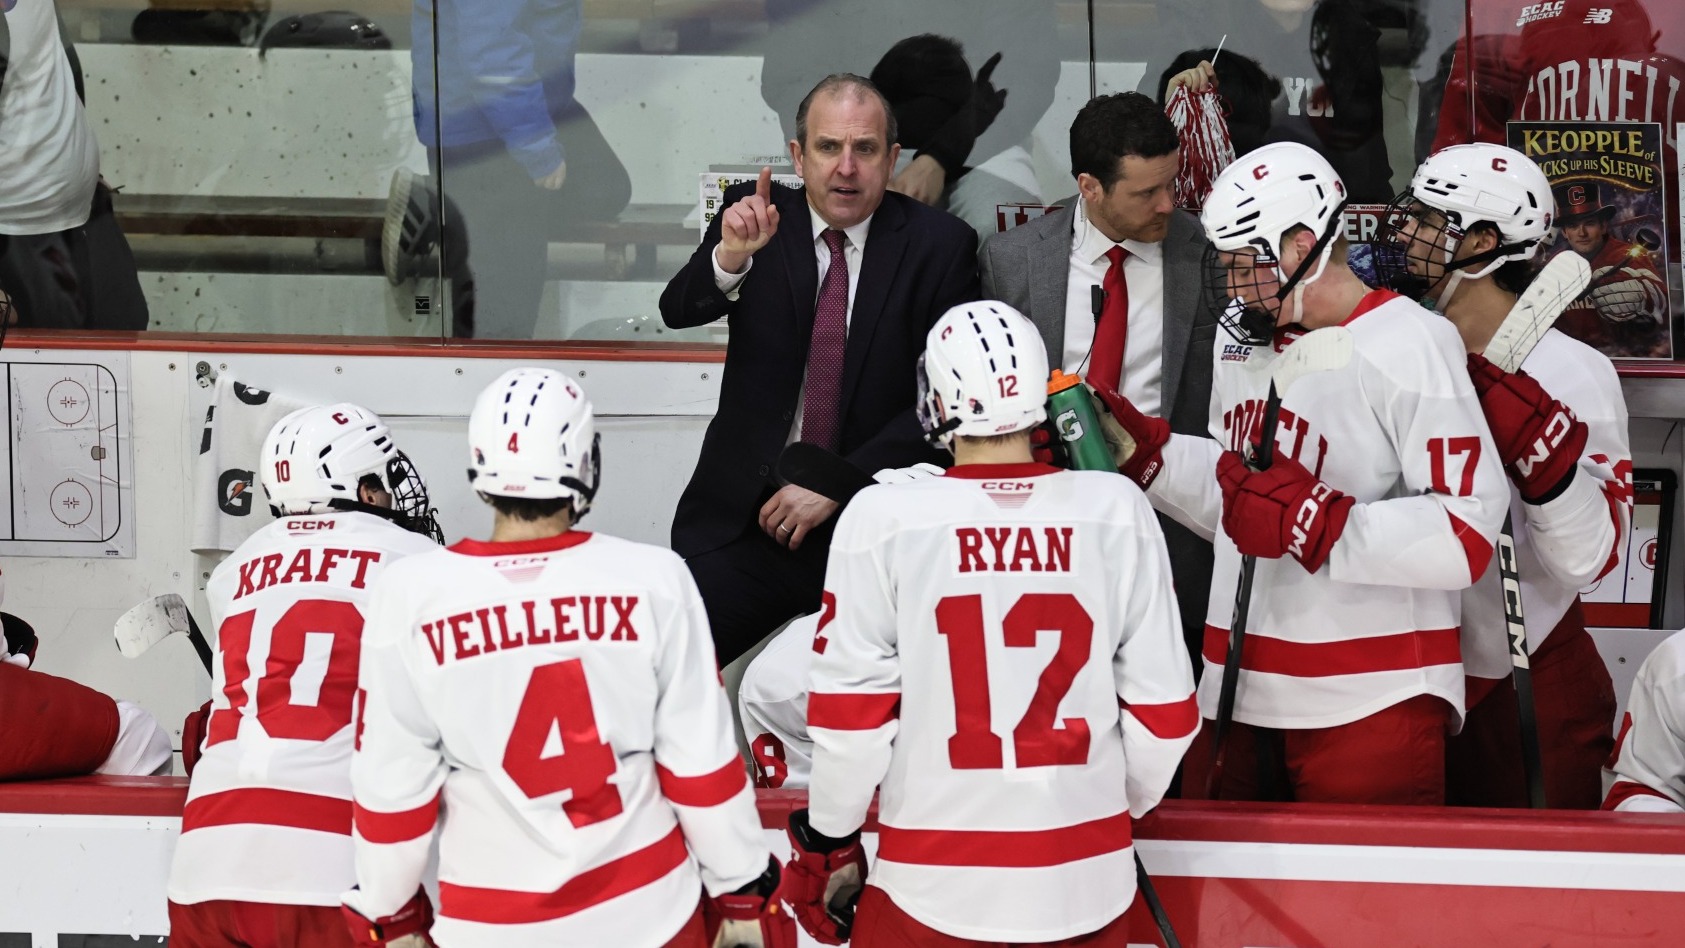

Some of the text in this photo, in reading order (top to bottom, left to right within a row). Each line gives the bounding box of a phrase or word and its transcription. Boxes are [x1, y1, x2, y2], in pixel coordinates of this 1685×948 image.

[1521, 1, 1565, 17] ECAC
[1524, 10, 1562, 24] HOCKEY
[1522, 129, 1656, 162] KEOPPLE of
[1252, 164, 1269, 181] C
[1491, 158, 1508, 173] C
[1538, 155, 1654, 184] ICKS UP HIS SLEEVE
[1567, 186, 1586, 206] C
[1223, 344, 1253, 356] ECAC
[997, 374, 1019, 399] 12
[332, 411, 349, 425] C
[1055, 408, 1084, 442] G
[507, 431, 519, 454] 4
[274, 459, 290, 483] 10
[1426, 436, 1482, 497] 17
[217, 467, 256, 517] G
[981, 482, 1035, 491] CCM
[286, 520, 336, 530] CCM
[1287, 481, 1333, 559] CCM
[956, 527, 1074, 573] RYAN
[233, 548, 381, 601] KRAFT
[1500, 533, 1531, 670] CCM
[421, 595, 639, 666] VEILLEUX
[205, 598, 366, 750] 10
[934, 593, 1094, 769] 12
[502, 658, 624, 830] 4
